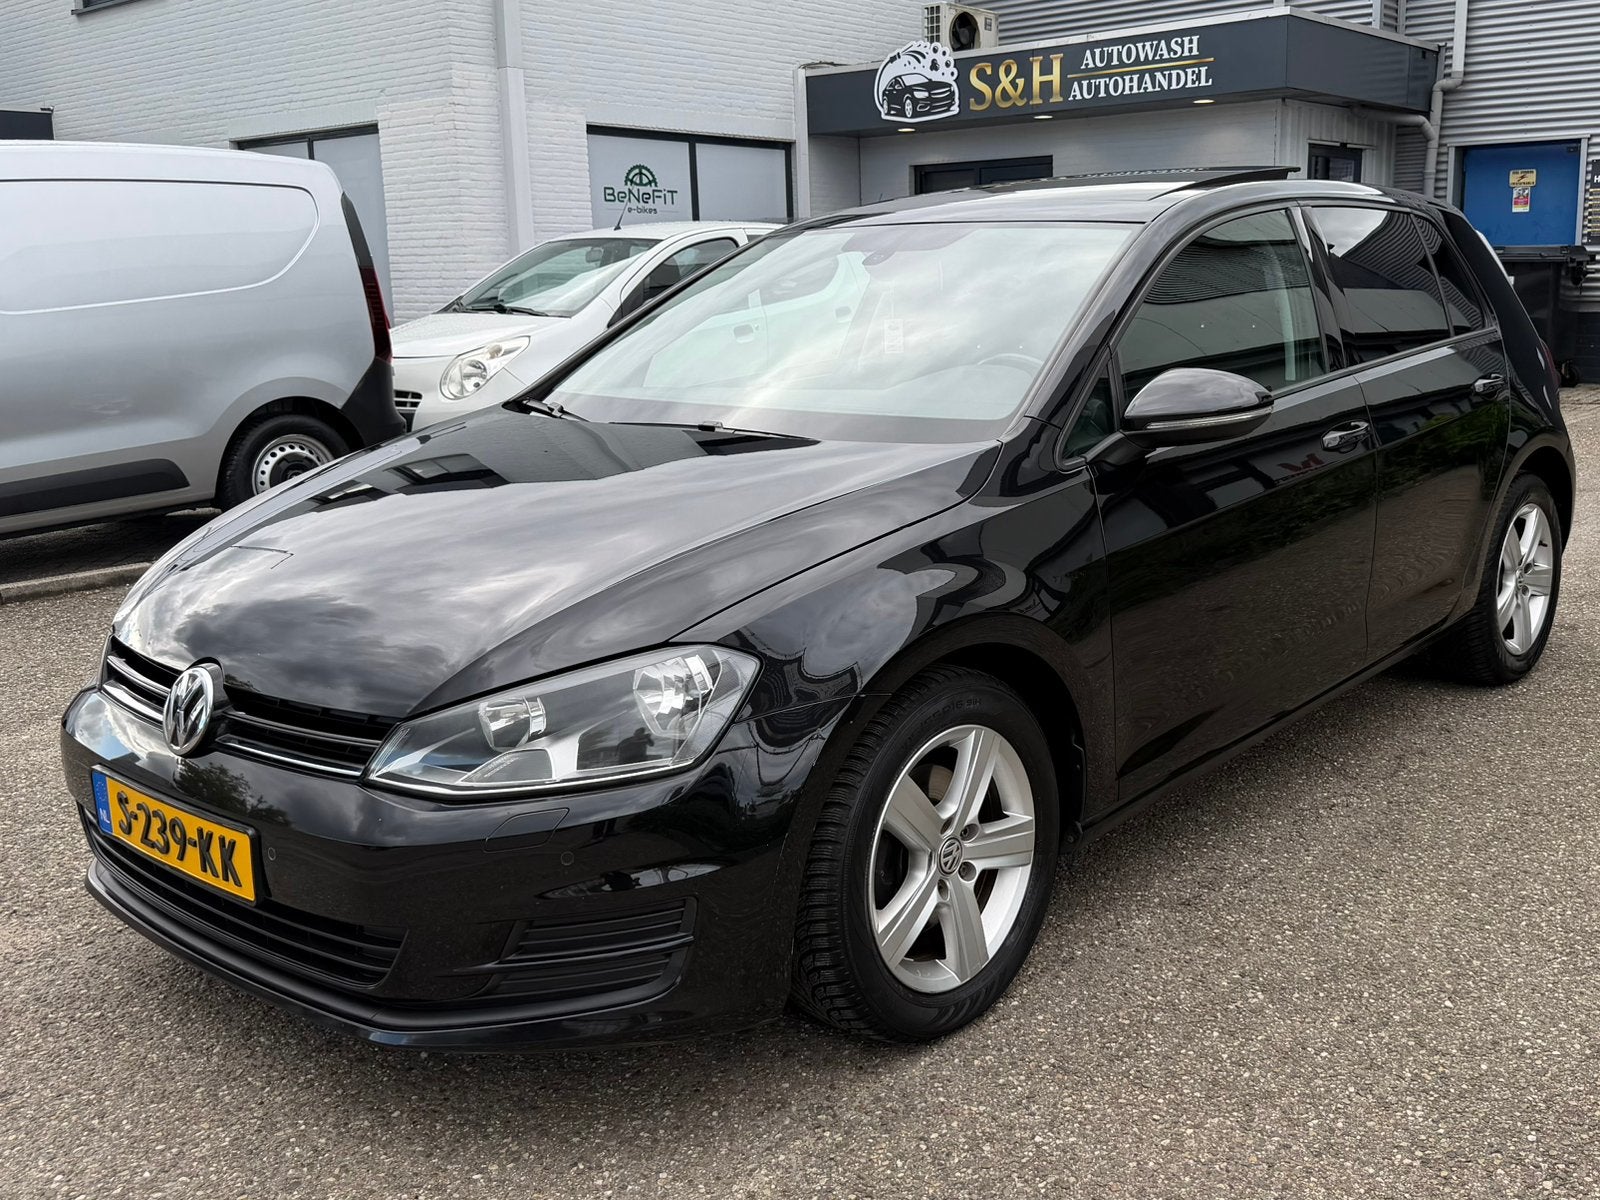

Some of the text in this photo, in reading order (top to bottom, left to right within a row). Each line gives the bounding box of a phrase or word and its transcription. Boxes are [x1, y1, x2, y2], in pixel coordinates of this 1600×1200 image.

[1080, 35, 1200, 69] AUTOWASH
[969, 53, 1064, 111] S&H
[1068, 66, 1213, 101] AUTOHANDEL
[627, 205, 658, 214] e-bikes
[99, 790, 243, 888] NL S-239-KK
